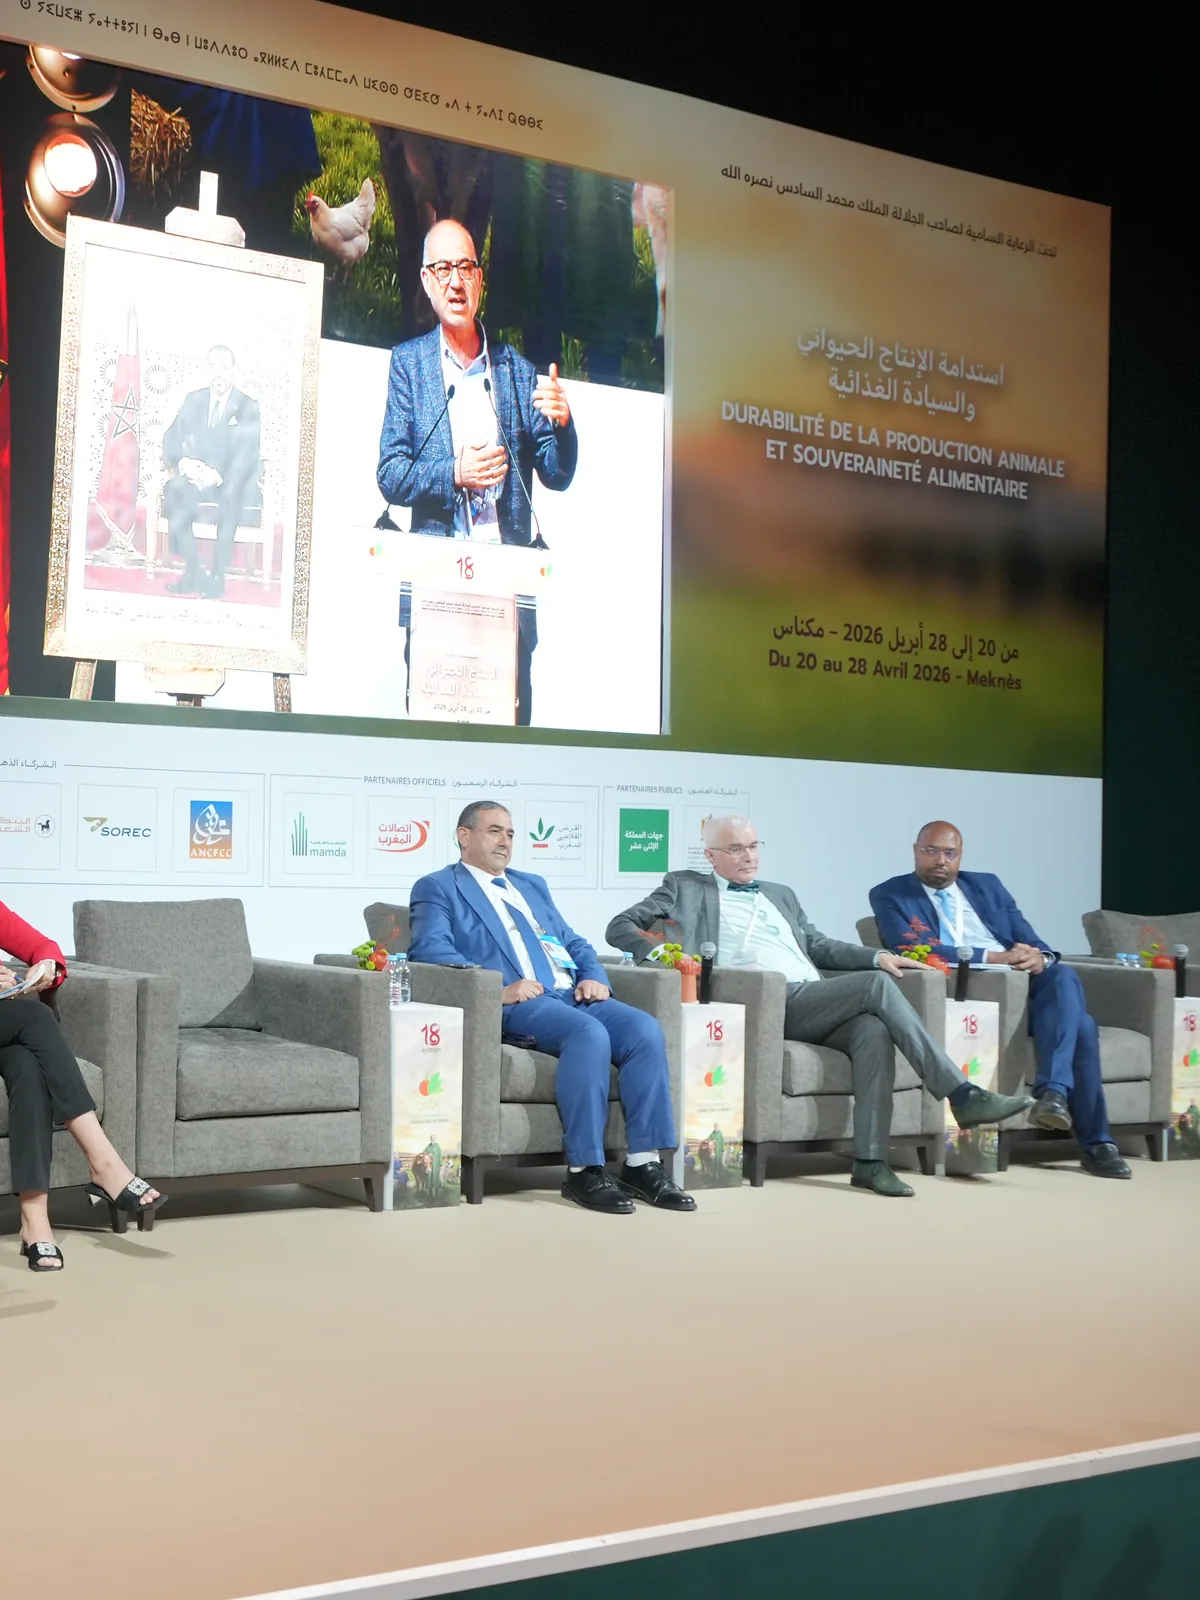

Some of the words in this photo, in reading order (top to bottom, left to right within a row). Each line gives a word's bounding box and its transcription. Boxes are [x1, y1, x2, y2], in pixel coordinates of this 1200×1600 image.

[721, 164, 741, 181] الله
[744, 173, 773, 189] نصره
[776, 182, 823, 202] السادس
[825, 191, 855, 209] محمد
[857, 199, 889, 217] الملك
[891, 206, 924, 227] الجلالة
[927, 220, 964, 236] لصاحب
[965, 224, 1004, 247] السامية
[1006, 236, 1036, 255] الرعاية
[1037, 245, 1058, 258] تحت
[797, 327, 874, 362] الحيواني
[878, 342, 934, 379] الإنتاج
[937, 351, 1005, 386] استدامة
[828, 366, 898, 402] الغذائية
[902, 378, 976, 423] والسيادة
[721, 400, 825, 438] DURABILITÉ
[830, 420, 853, 442] DE
[857, 427, 880, 447] LA
[886, 429, 992, 467] PRODUCTION
[998, 450, 1065, 478] ANIMALE
[765, 439, 788, 460] ET
[793, 443, 922, 484] SOUVERAINETÉ
[927, 465, 1029, 500] ALIMENTAIRE
[773, 615, 825, 640] مكناس
[843, 623, 884, 645] 2026
[888, 622, 924, 656] أبريل
[928, 633, 948, 652] 28
[978, 639, 996, 657] 20
[952, 635, 974, 662] إلى
[1000, 646, 1019, 664] من
[769, 649, 791, 667] Du
[796, 652, 817, 670] 20
[823, 657, 842, 673] au
[848, 657, 868, 675] 28
[872, 660, 908, 679] Avril
[913, 664, 950, 683] 2026
[967, 669, 1022, 690] Meknès
[20, 758, 57, 770] الشركاء
[363, 775, 411, 786] PARTENAIRES
[411, 777, 446, 788] OFFICIELS
[452, 779, 488, 788] الرسميون
[490, 779, 518, 789] الشركاء
[616, 784, 658, 794] PARTENAIRES
[658, 786, 683, 795] PUBLICS
[100, 826, 152, 838] SOREC
[378, 823, 412, 834] اتصالات
[378, 834, 412, 846] المغرب
[190, 848, 232, 858] ANCFCC
[309, 848, 347, 857] mamda
